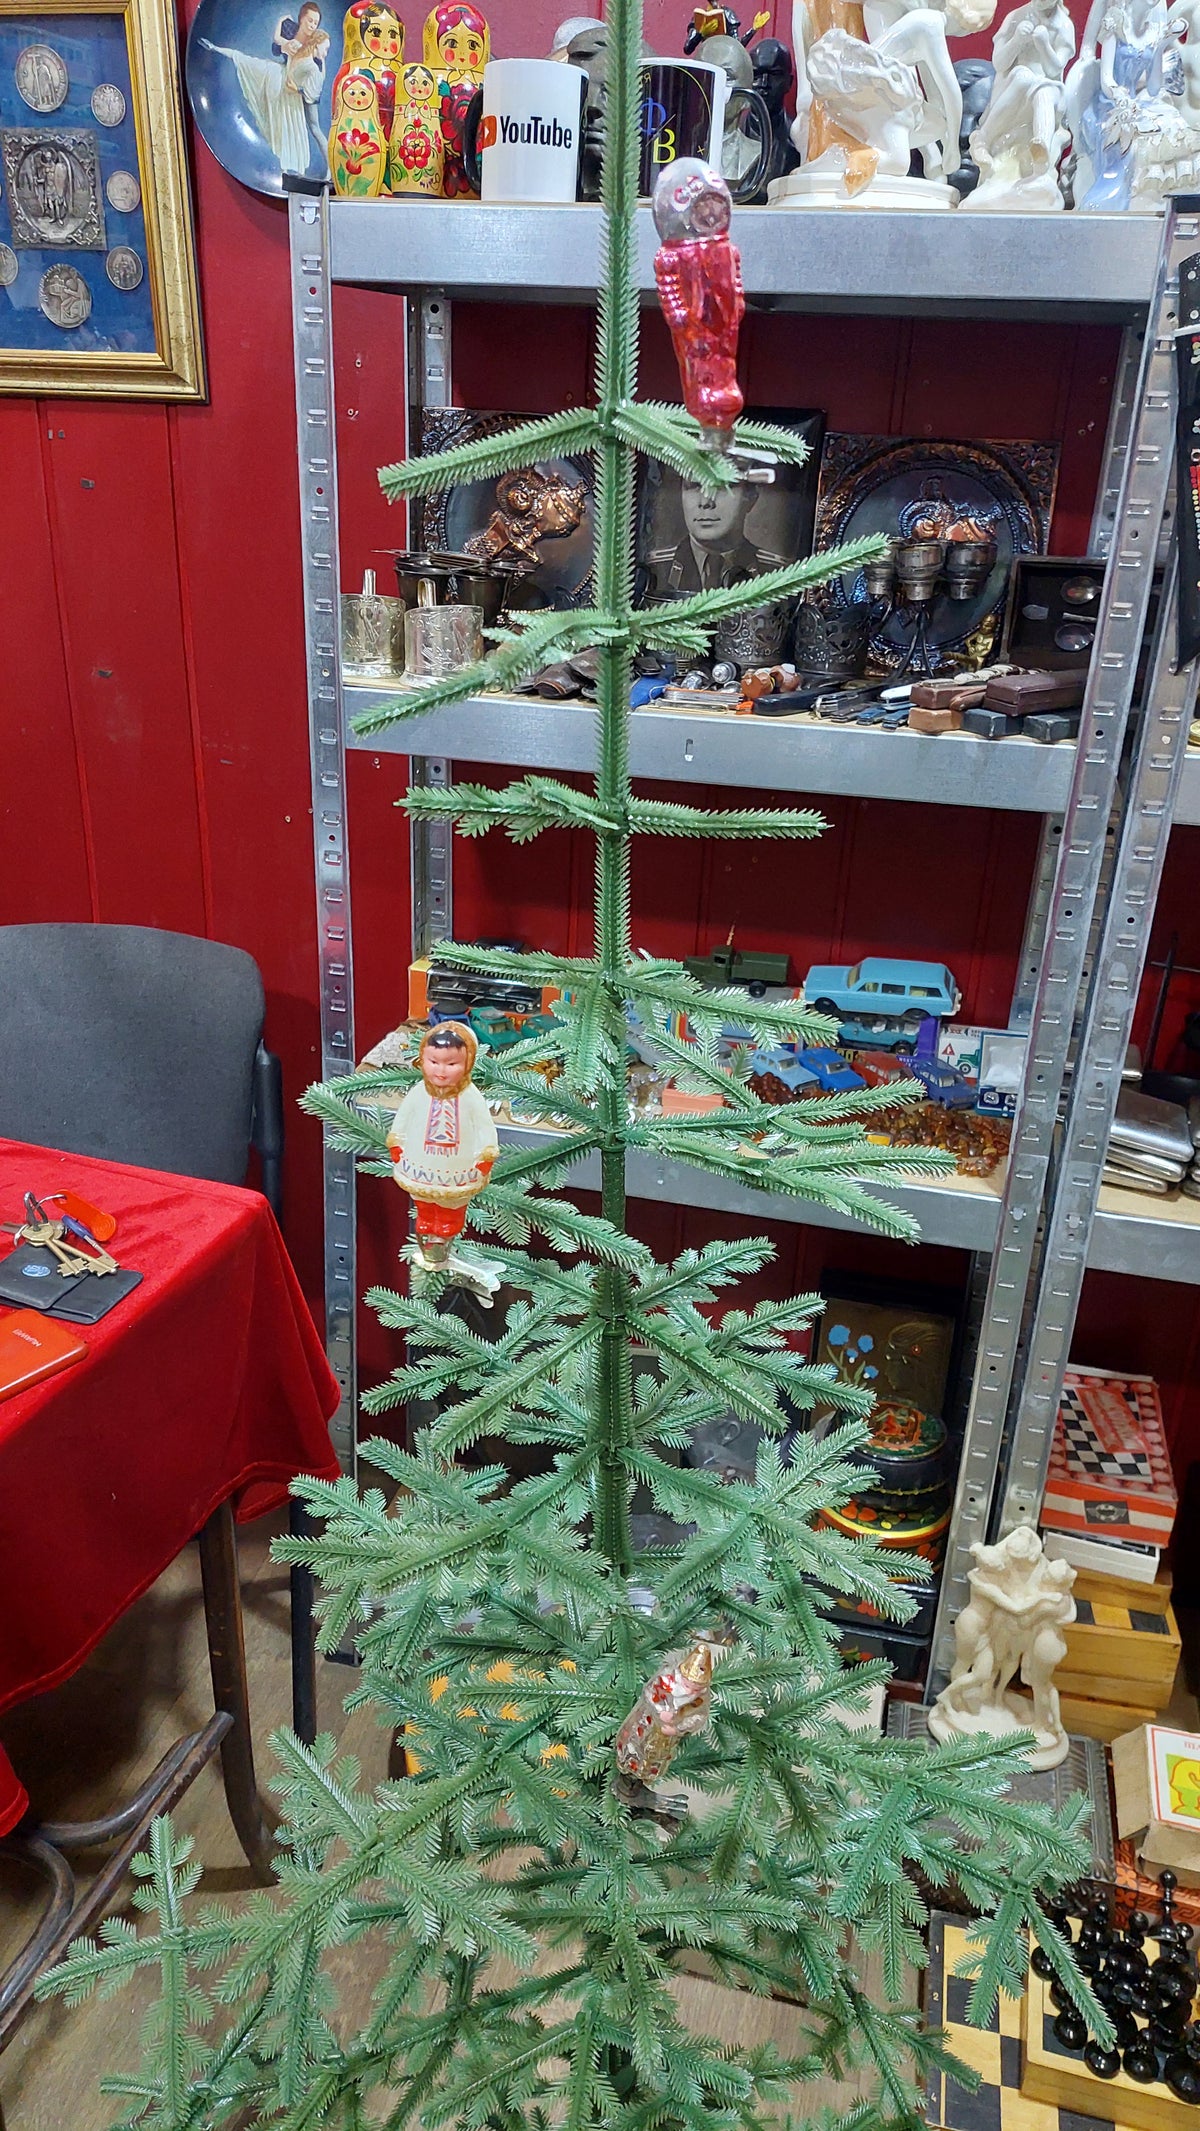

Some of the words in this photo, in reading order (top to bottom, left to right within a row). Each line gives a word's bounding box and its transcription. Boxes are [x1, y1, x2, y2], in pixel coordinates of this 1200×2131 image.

[499, 115, 572, 149] YouTube
[932, 1991, 939, 2002] 2
[930, 2092, 937, 2104] 4
